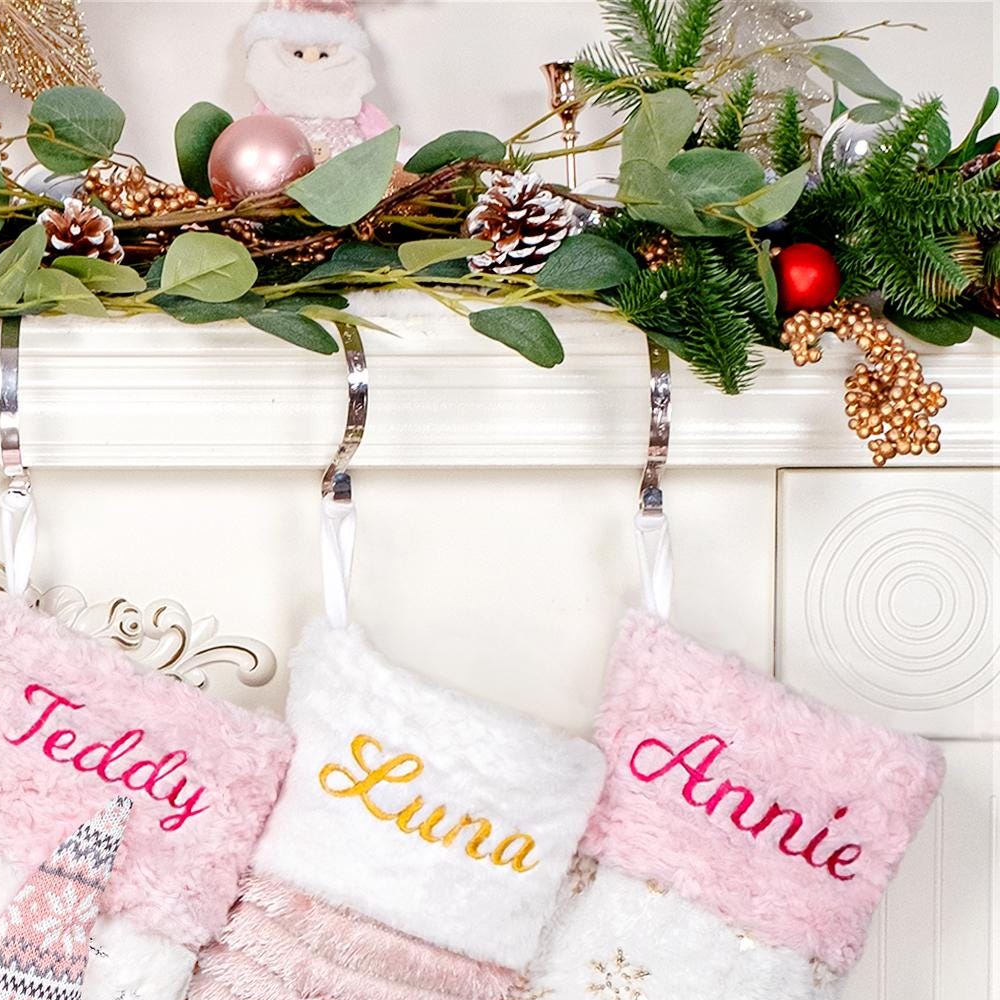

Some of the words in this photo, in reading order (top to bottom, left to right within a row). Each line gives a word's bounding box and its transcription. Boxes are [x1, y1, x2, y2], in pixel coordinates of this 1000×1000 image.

[5, 683, 208, 831] Teddy
[319, 733, 538, 873] Luna
[629, 734, 861, 882] Annie
